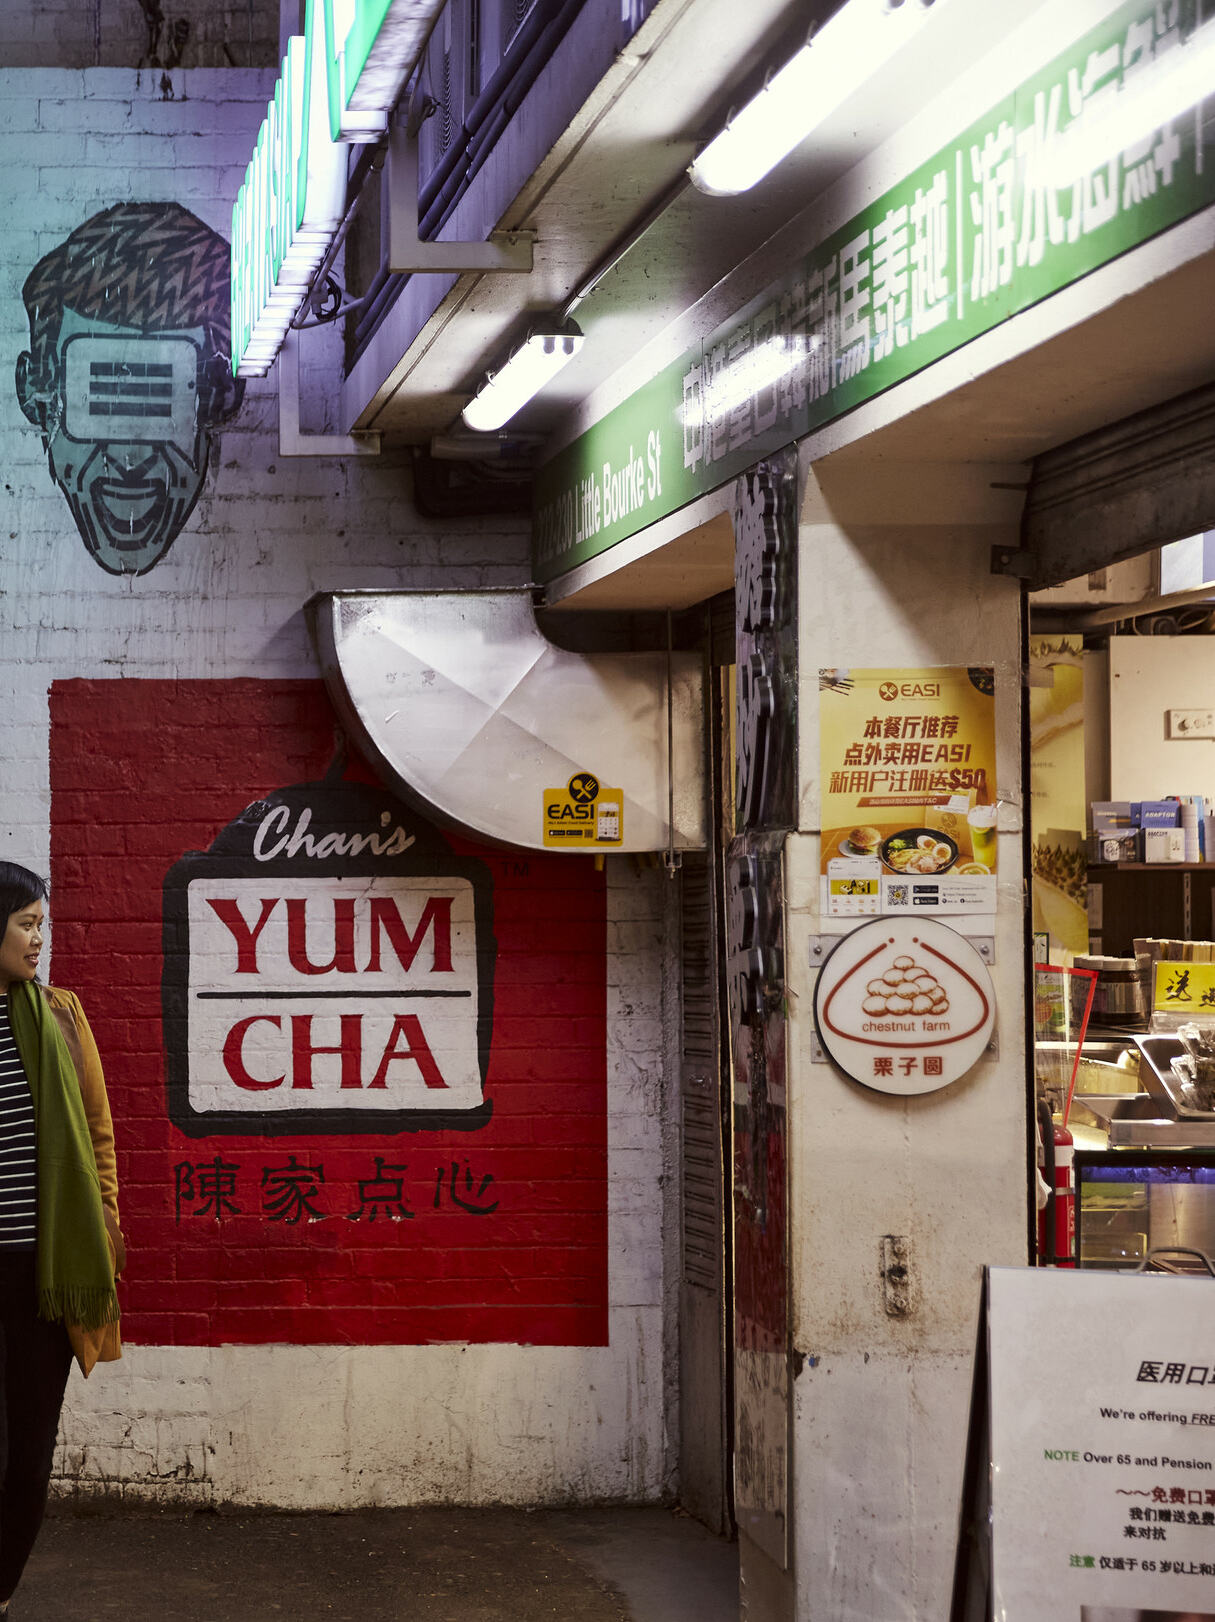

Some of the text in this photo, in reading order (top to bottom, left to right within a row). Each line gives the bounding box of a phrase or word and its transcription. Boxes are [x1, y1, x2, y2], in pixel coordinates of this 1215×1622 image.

[575, 473, 600, 544] Little
[603, 445, 644, 528] Bourke
[647, 428, 662, 501] St
[901, 683, 940, 697] EASI
[863, 715, 960, 739] 本餐厅推荐
[547, 804, 595, 819] EASI
[251, 804, 416, 861] Chan's
[205, 896, 456, 975] YUM
[862, 1020, 951, 1032] chestnut farm
[222, 1013, 451, 1091] CHA
[1100, 1408, 1135, 1419] We're
[1139, 1411, 1187, 1425] offering
[1044, 1449, 1212, 1470] NOTE Over 65 and Pension
[1123, 1525, 1166, 1541] 来对抗
[1069, 1554, 1095, 1568] 注意
[1141, 1561, 1156, 1571] 65
[1160, 1561, 1215, 1576] 岁以上和
